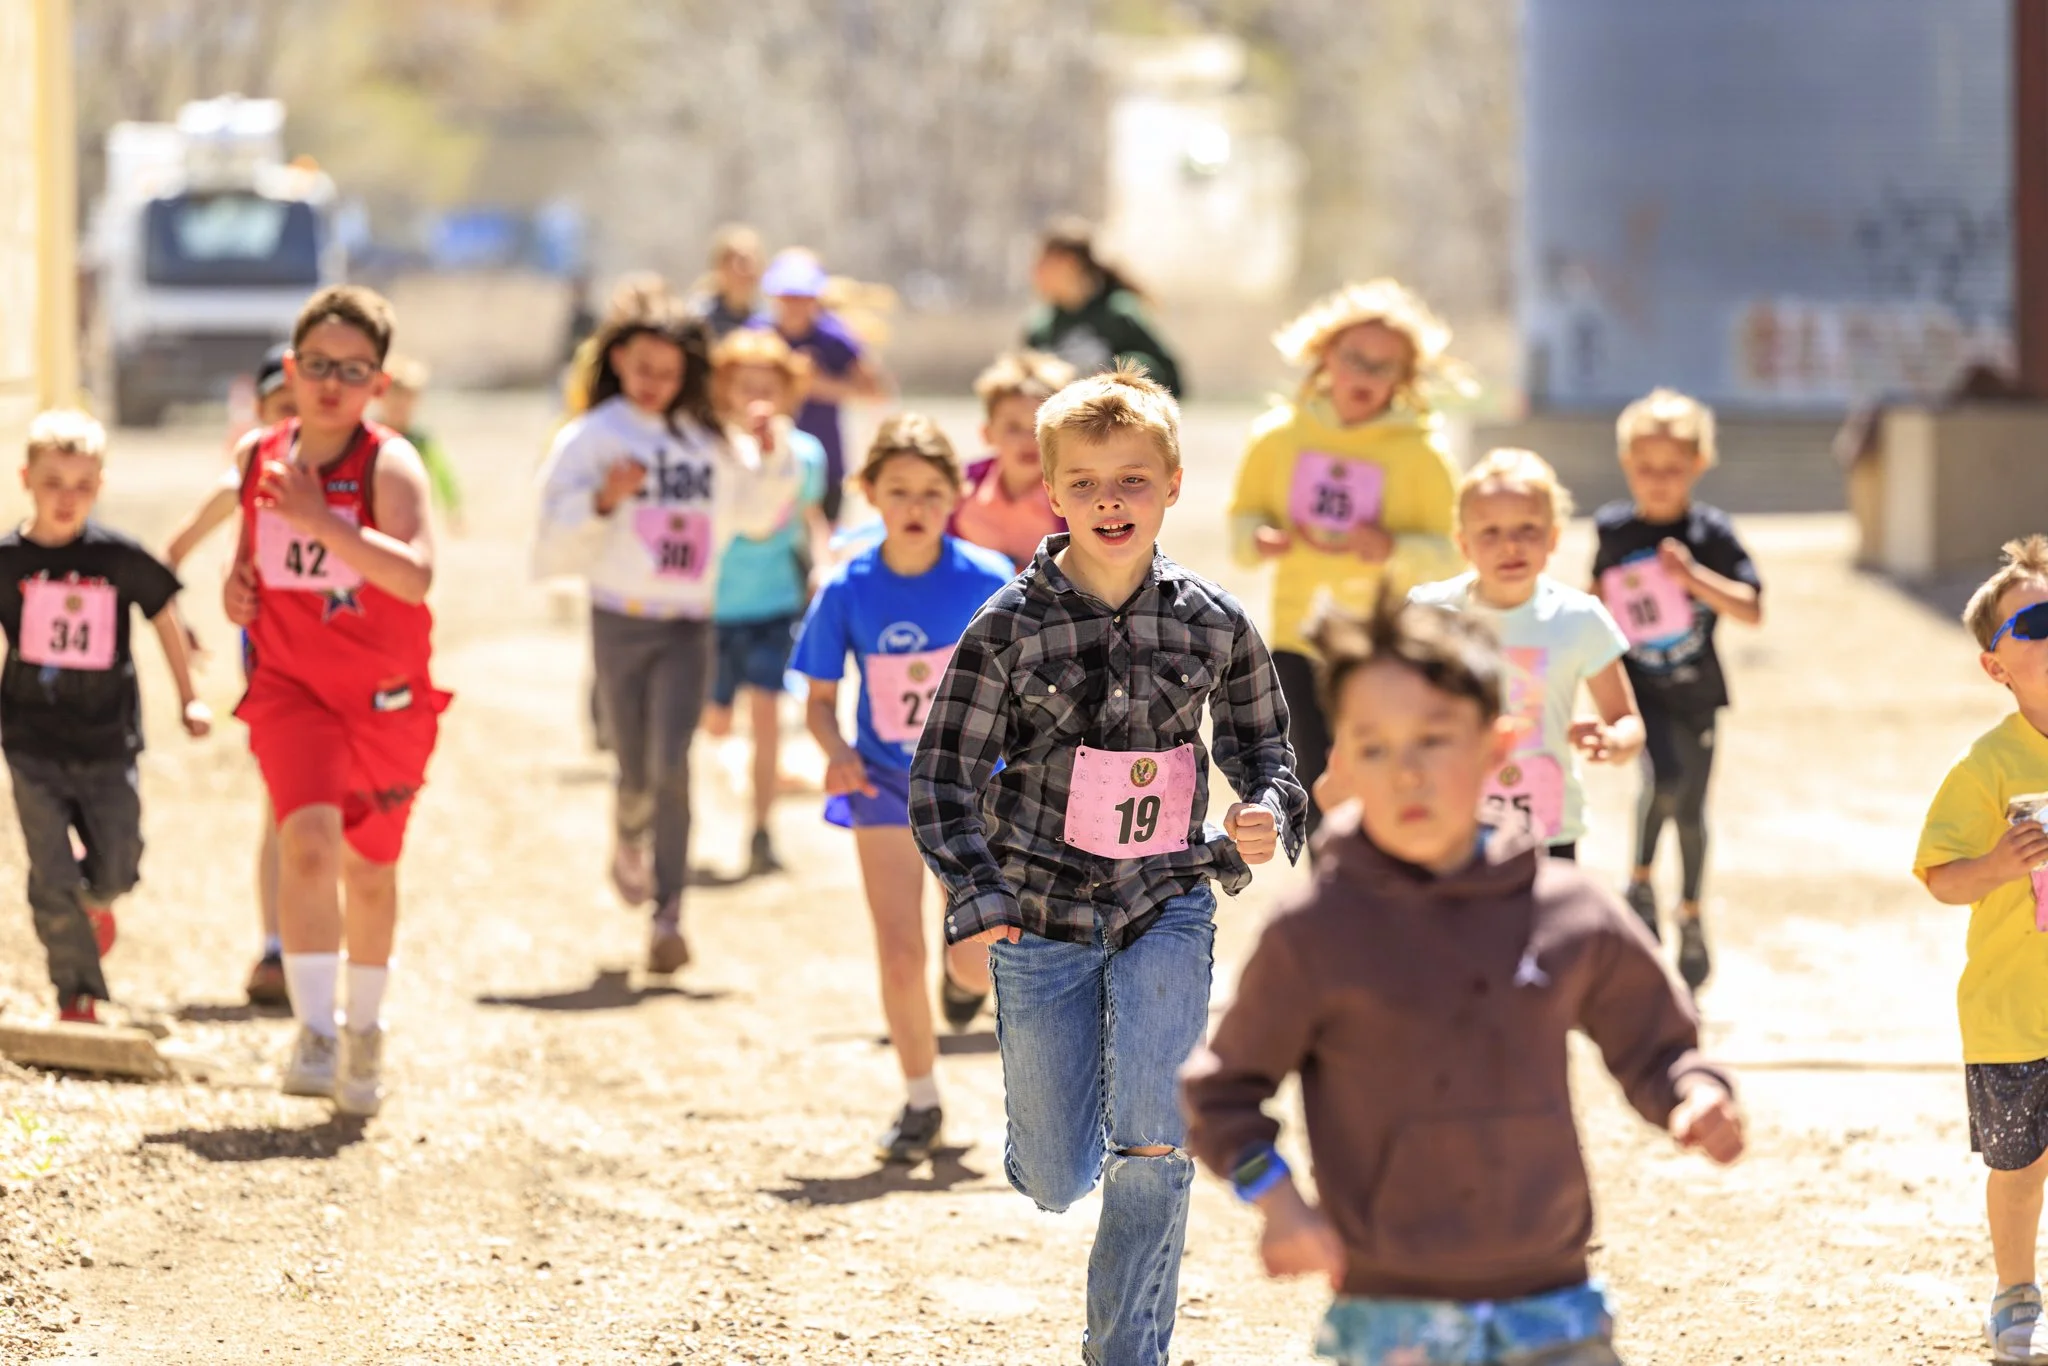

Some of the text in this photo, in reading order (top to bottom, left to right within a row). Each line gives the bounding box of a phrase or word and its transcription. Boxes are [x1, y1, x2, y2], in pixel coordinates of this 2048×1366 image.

[285, 540, 327, 577] 42
[50, 617, 90, 654] 34
[901, 688, 936, 728] 2
[1114, 795, 1161, 845] 19
